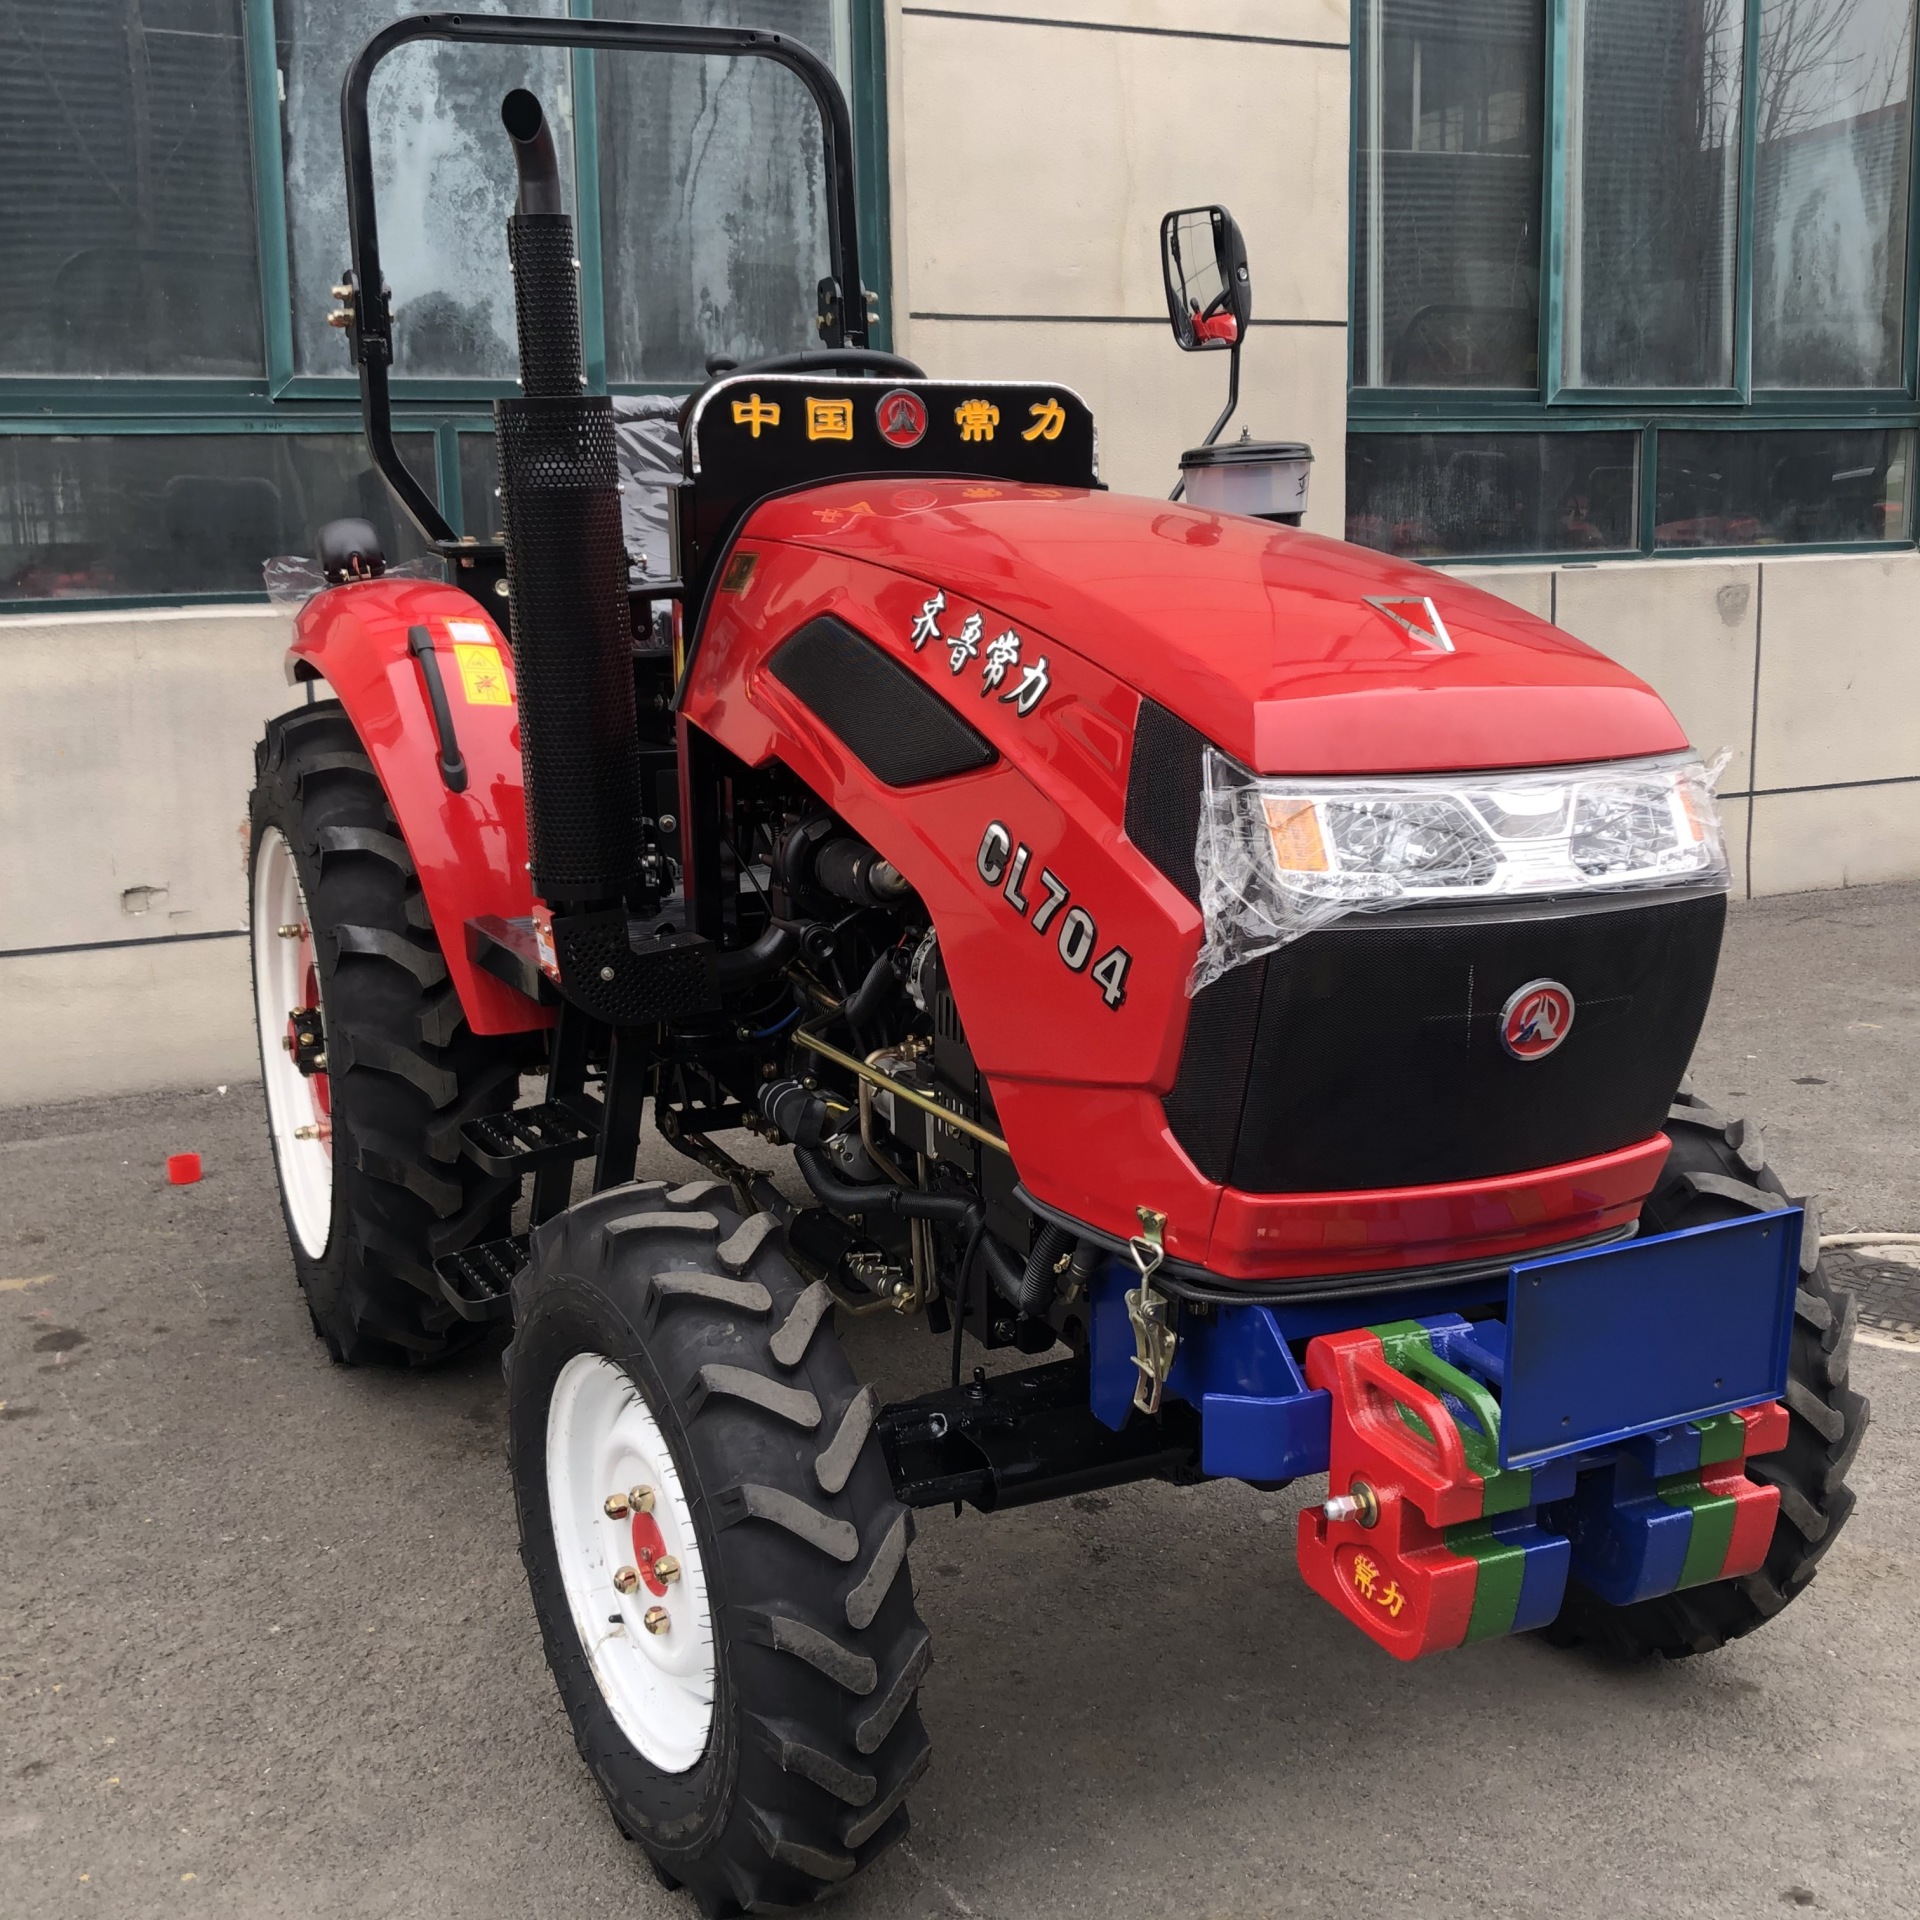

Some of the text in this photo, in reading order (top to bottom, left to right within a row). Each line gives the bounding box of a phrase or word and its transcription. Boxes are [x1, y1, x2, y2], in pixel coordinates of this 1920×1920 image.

[731, 393, 1066, 442] 中国 常力
[910, 588, 1052, 717] 齐鲁常力
[976, 819, 1133, 1012] CL704
[1353, 1552, 1407, 1618] 常力
